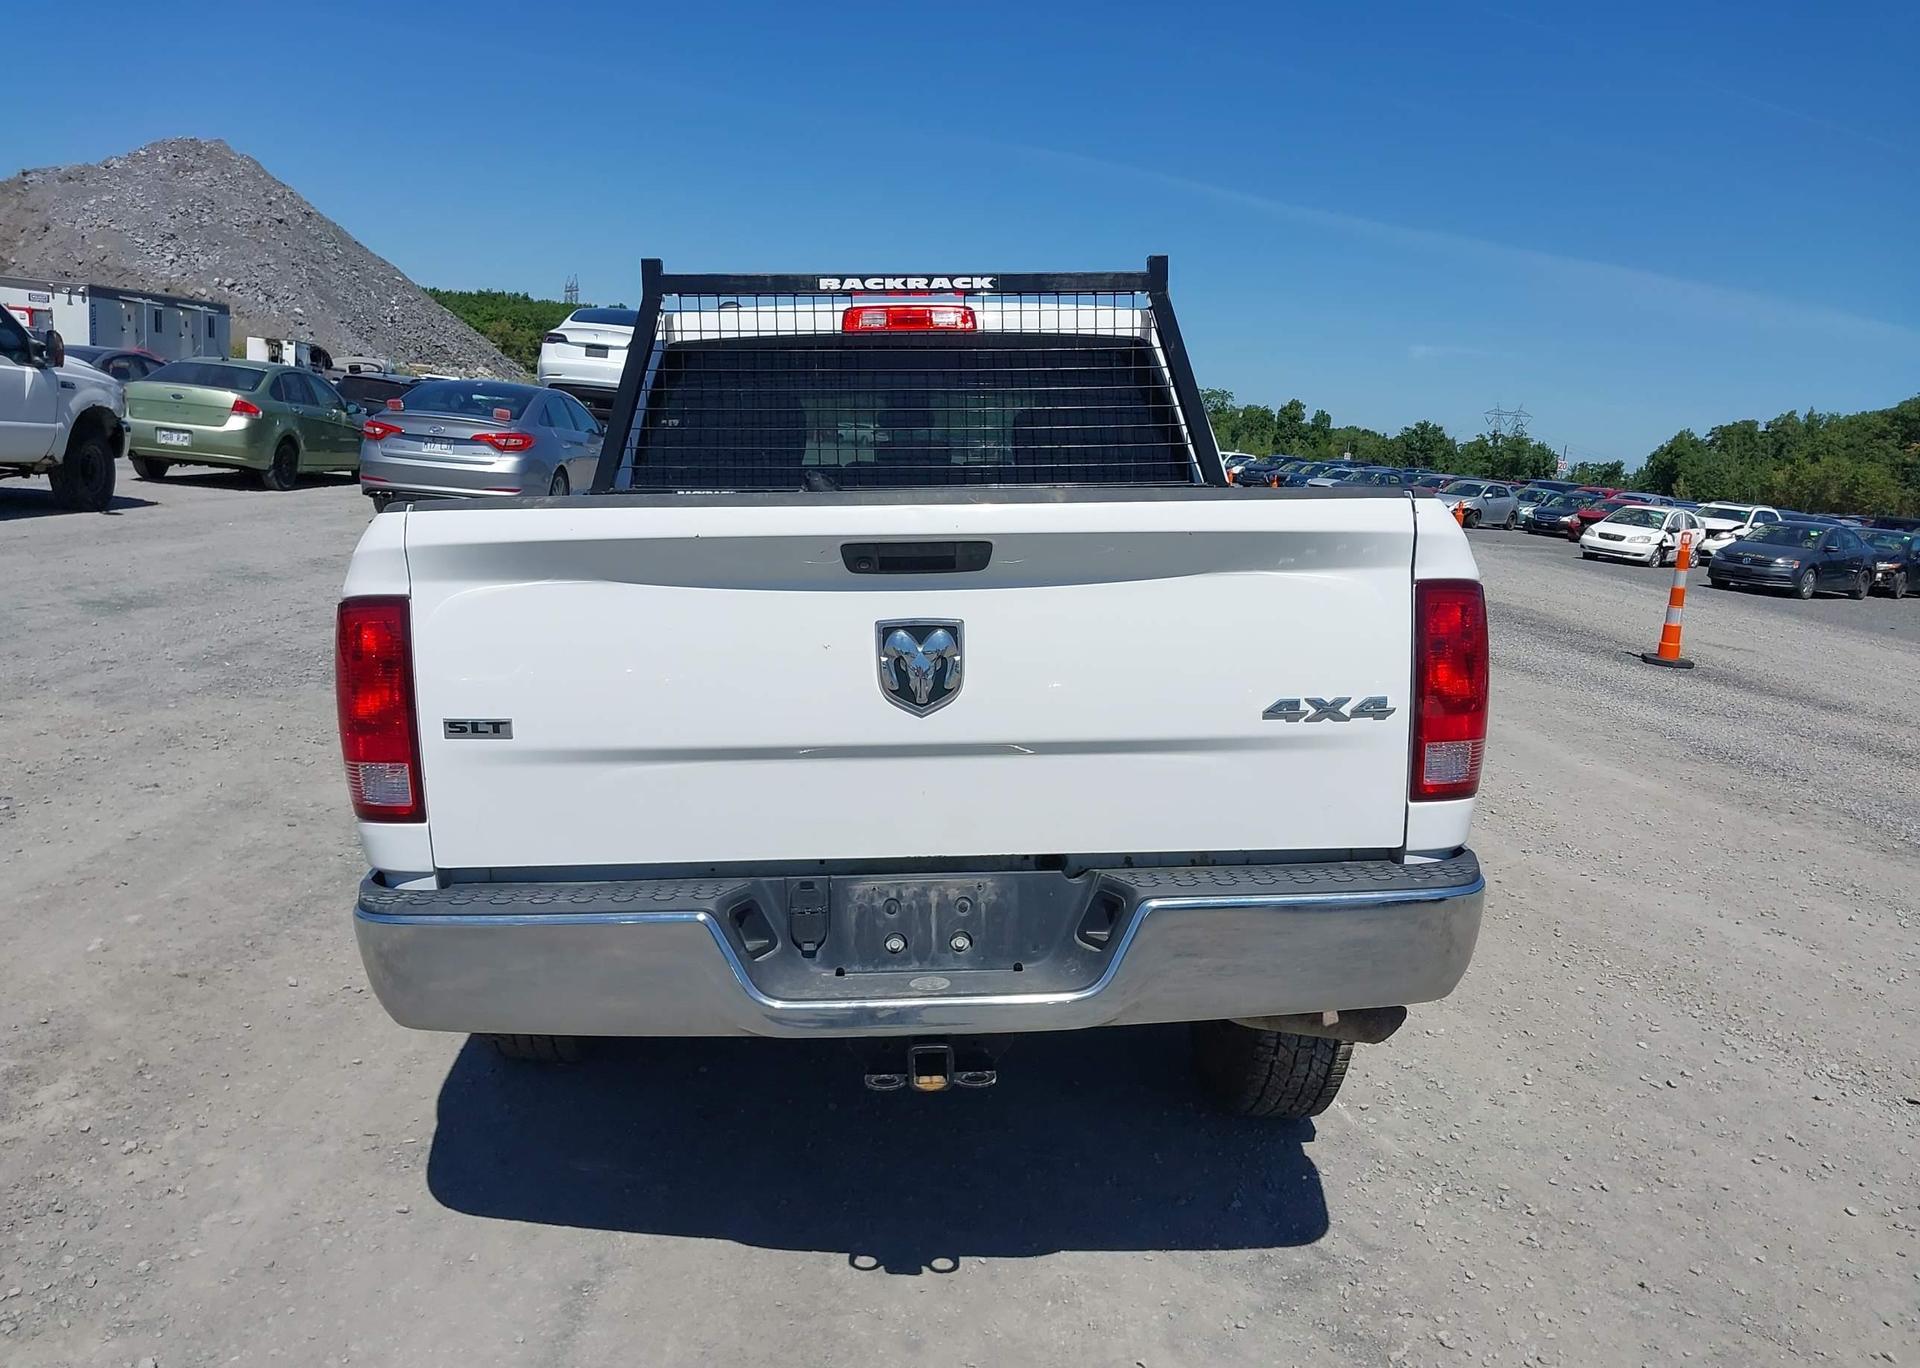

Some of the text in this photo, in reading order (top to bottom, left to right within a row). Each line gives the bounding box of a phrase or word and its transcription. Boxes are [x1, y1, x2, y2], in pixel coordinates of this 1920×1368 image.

[819, 277, 994, 290] BACKRACK
[1262, 696, 1396, 722] 4X4
[447, 721, 509, 734] SLT
